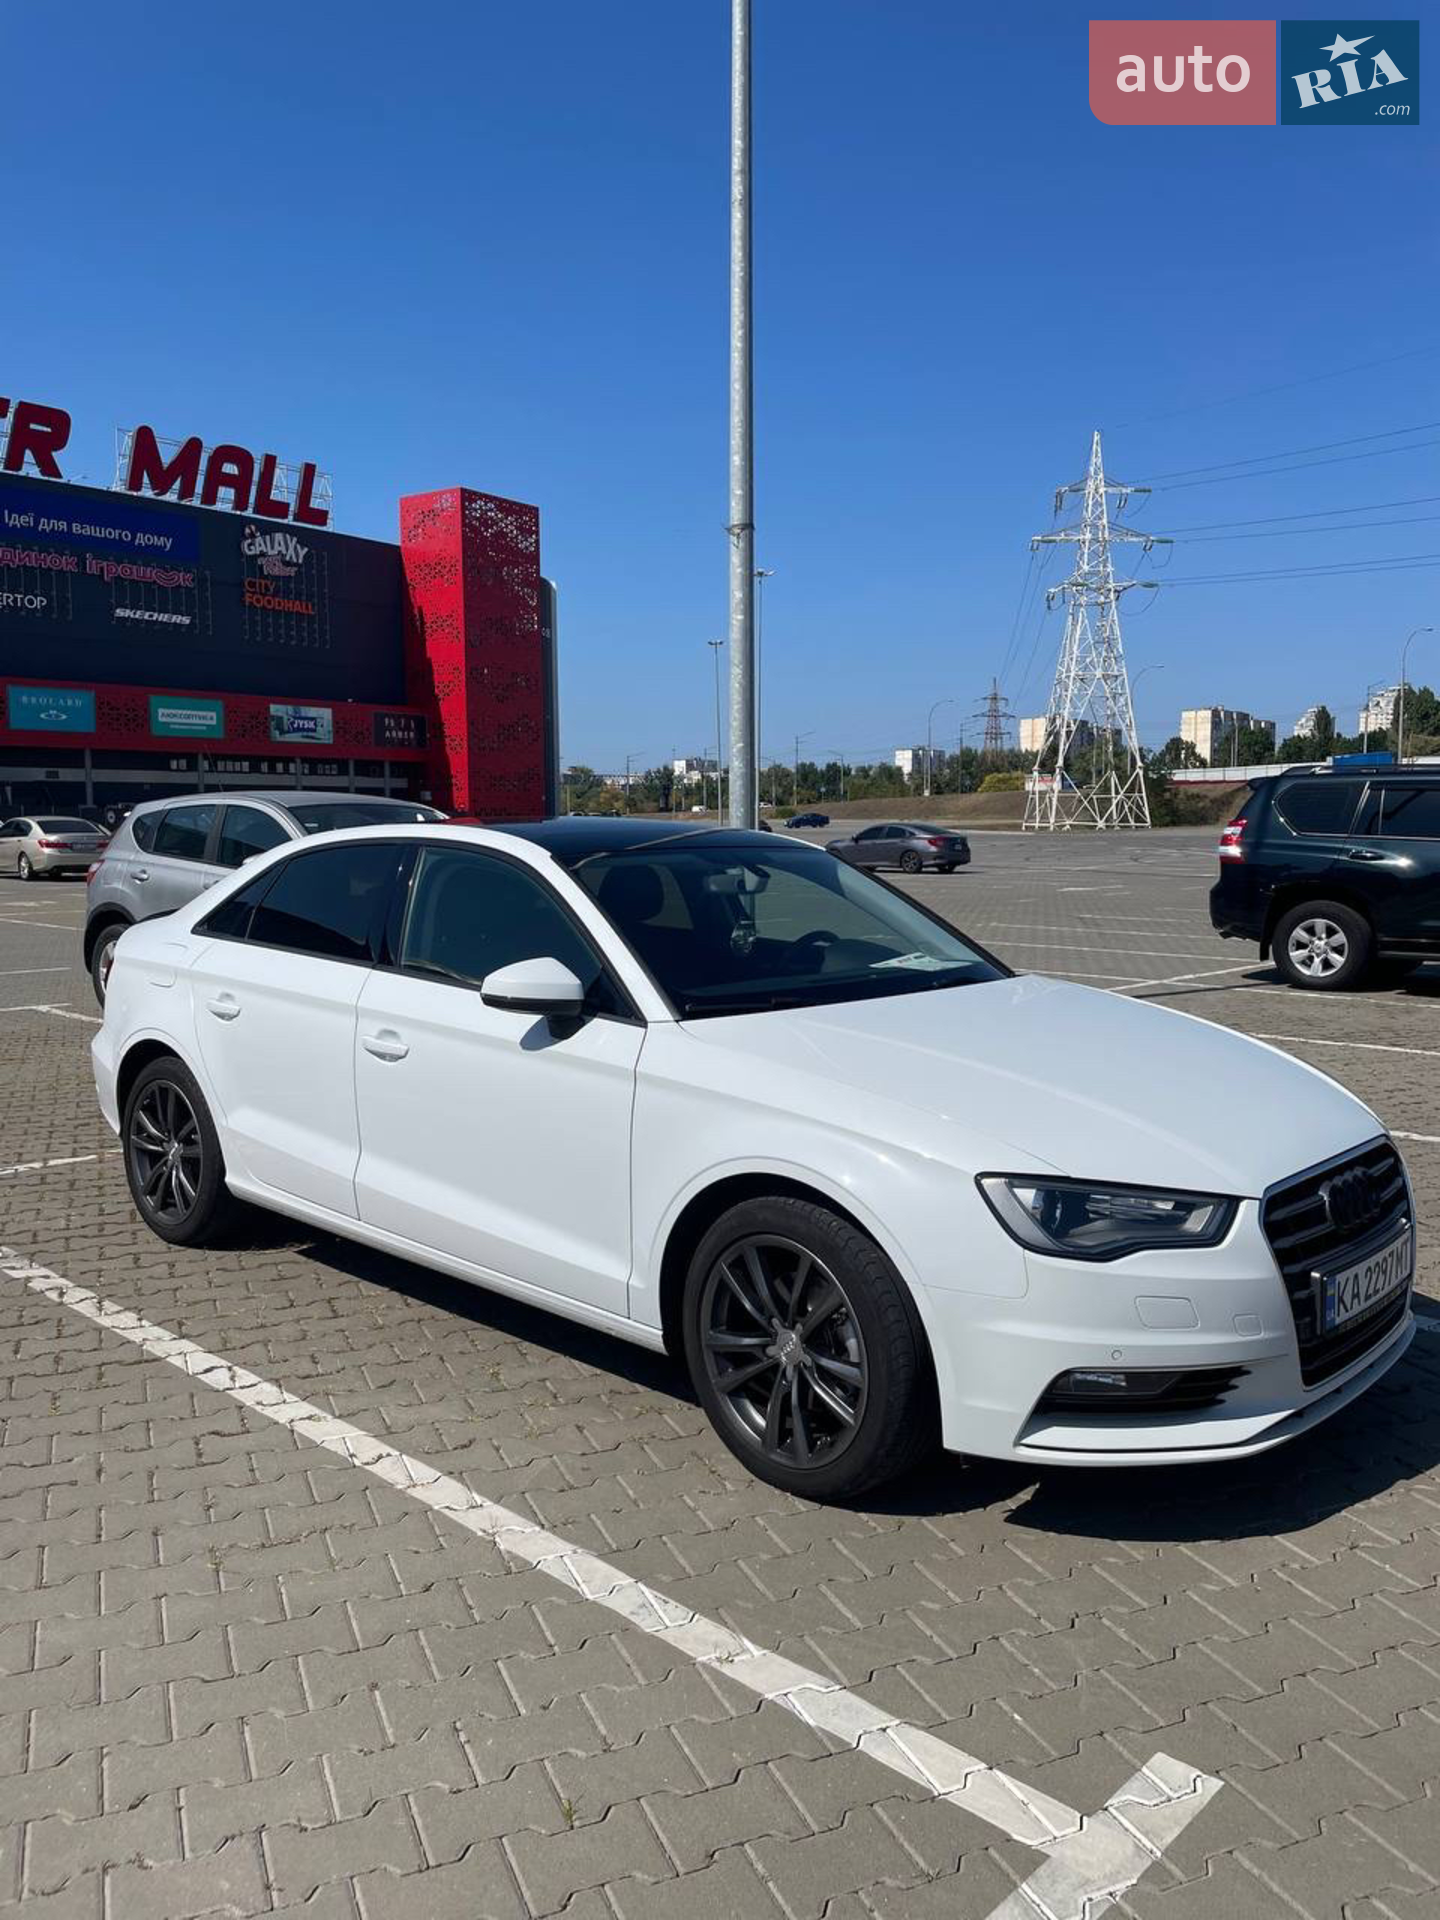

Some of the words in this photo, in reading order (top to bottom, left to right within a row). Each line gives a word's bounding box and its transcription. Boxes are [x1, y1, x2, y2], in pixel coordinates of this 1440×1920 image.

[0, 396, 71, 479] R
[127, 425, 329, 526] MALL
[4, 509, 35, 528] Ідеї
[38, 517, 68, 533] для
[71, 522, 132, 542] вашого
[134, 532, 173, 551] дому
[242, 532, 309, 564] GALAXY
[244, 577, 276, 595] CITY
[114, 607, 193, 625] SKECHERS
[244, 593, 315, 615] FOODHALL
[1337, 1271, 1361, 1318] KA
[1364, 1251, 1394, 1302] 2297
